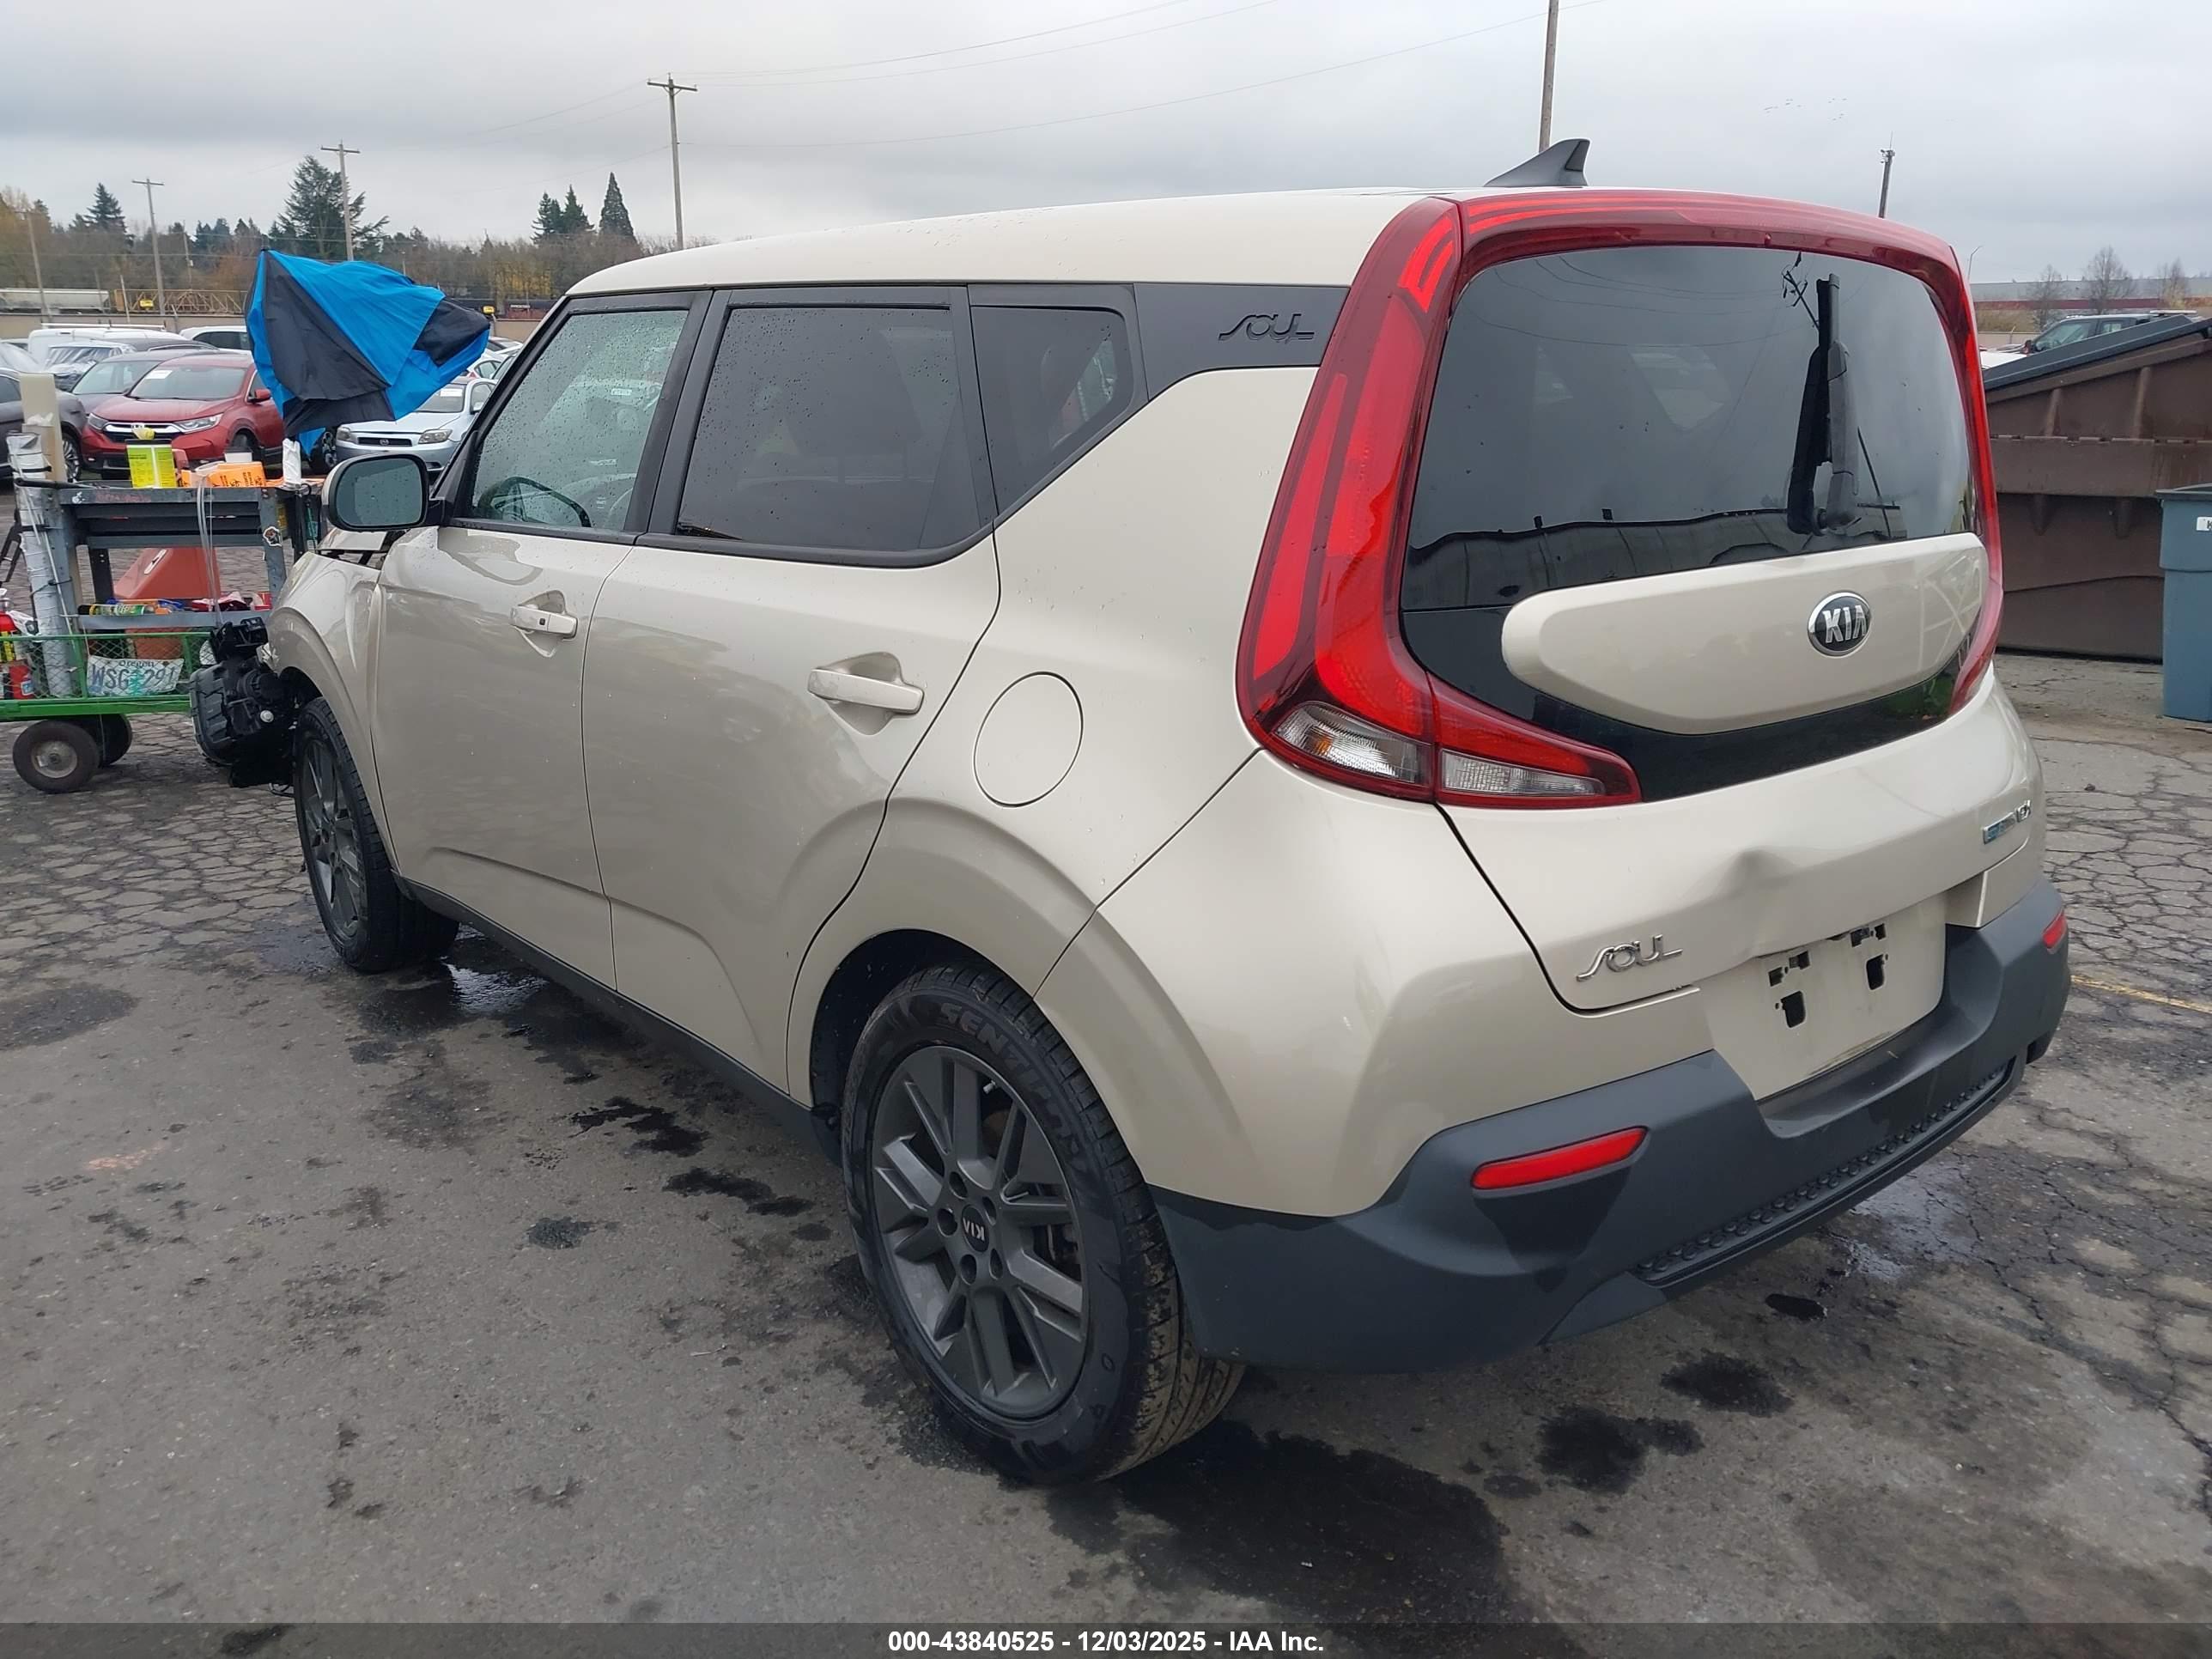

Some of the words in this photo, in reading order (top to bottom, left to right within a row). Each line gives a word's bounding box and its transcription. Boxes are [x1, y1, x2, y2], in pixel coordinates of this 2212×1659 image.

[1821, 605, 1868, 643] KIA
[118, 659, 155, 669] Oregon
[92, 664, 130, 690] WSG
[143, 666, 177, 689] 291
[963, 1217, 985, 1242] KIA
